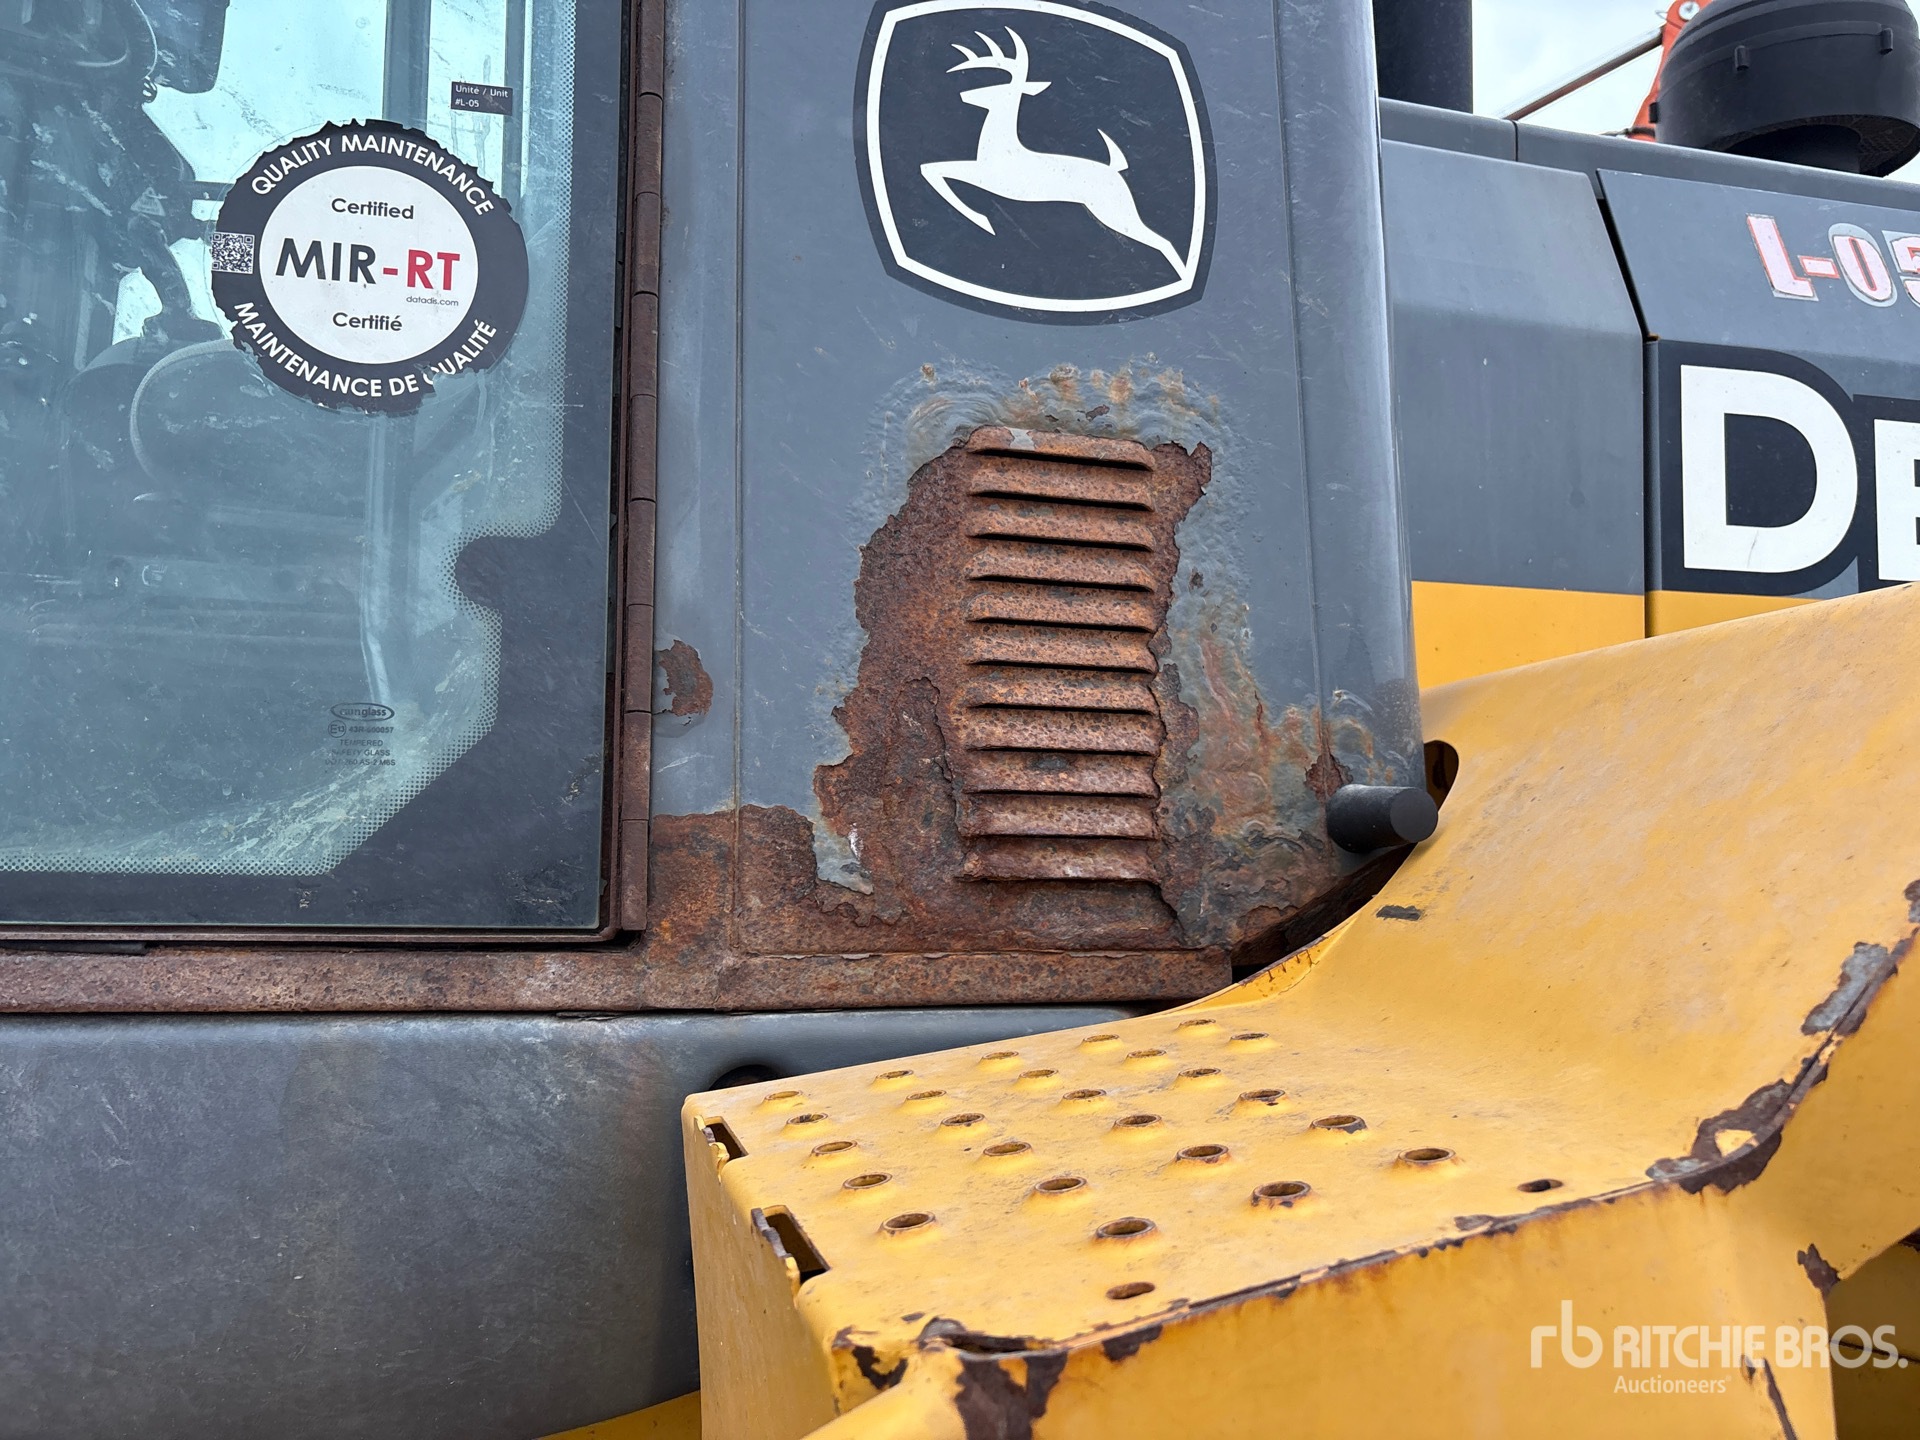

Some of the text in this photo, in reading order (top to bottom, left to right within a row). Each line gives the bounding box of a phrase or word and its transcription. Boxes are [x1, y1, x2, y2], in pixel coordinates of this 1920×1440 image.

[455, 85, 480, 95] Unité
[490, 88, 509, 98] Unit
[455, 98, 480, 108] #L-05
[251, 134, 495, 216] QUALITY MAINTENANCE
[331, 198, 414, 220] Certified
[275, 237, 461, 291] MIR-RT
[406, 295, 459, 307] datadis.com
[332, 312, 403, 332] Certifié
[234, 302, 382, 397] MAINTENANCE
[388, 374, 419, 396] DE
[364, 749, 391, 757] GLASS
